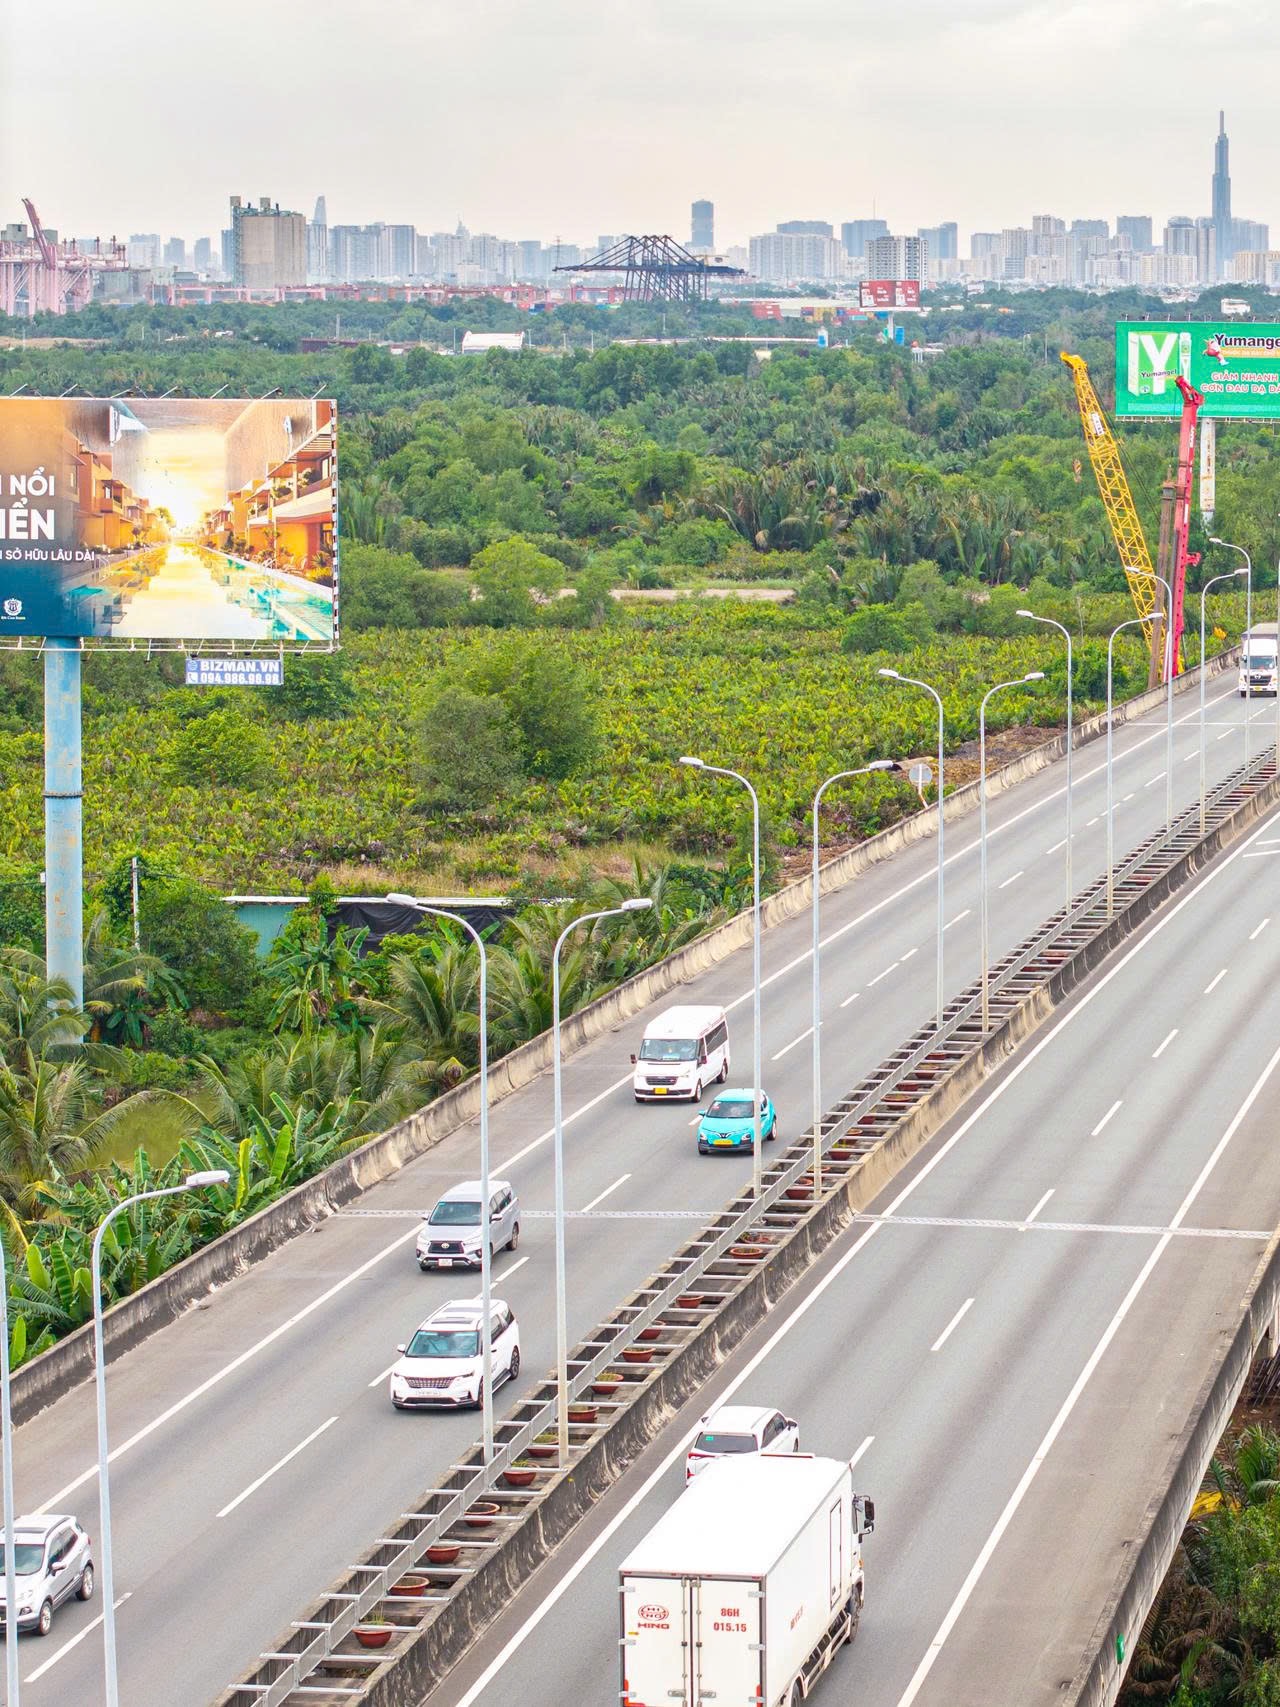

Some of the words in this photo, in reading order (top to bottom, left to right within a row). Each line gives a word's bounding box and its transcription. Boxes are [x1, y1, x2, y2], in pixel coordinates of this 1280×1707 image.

[1242, 373, 1279, 382] NHANH
[1226, 383, 1249, 393] ĐAU
[5, 547, 22, 561] SỞ
[25, 548, 48, 560] HỮU
[51, 549, 72, 561] LÂU
[201, 661, 279, 672] BIZMAN.VN
[720, 1608, 740, 1617] 86H
[713, 1622, 747, 1633] 015.15
